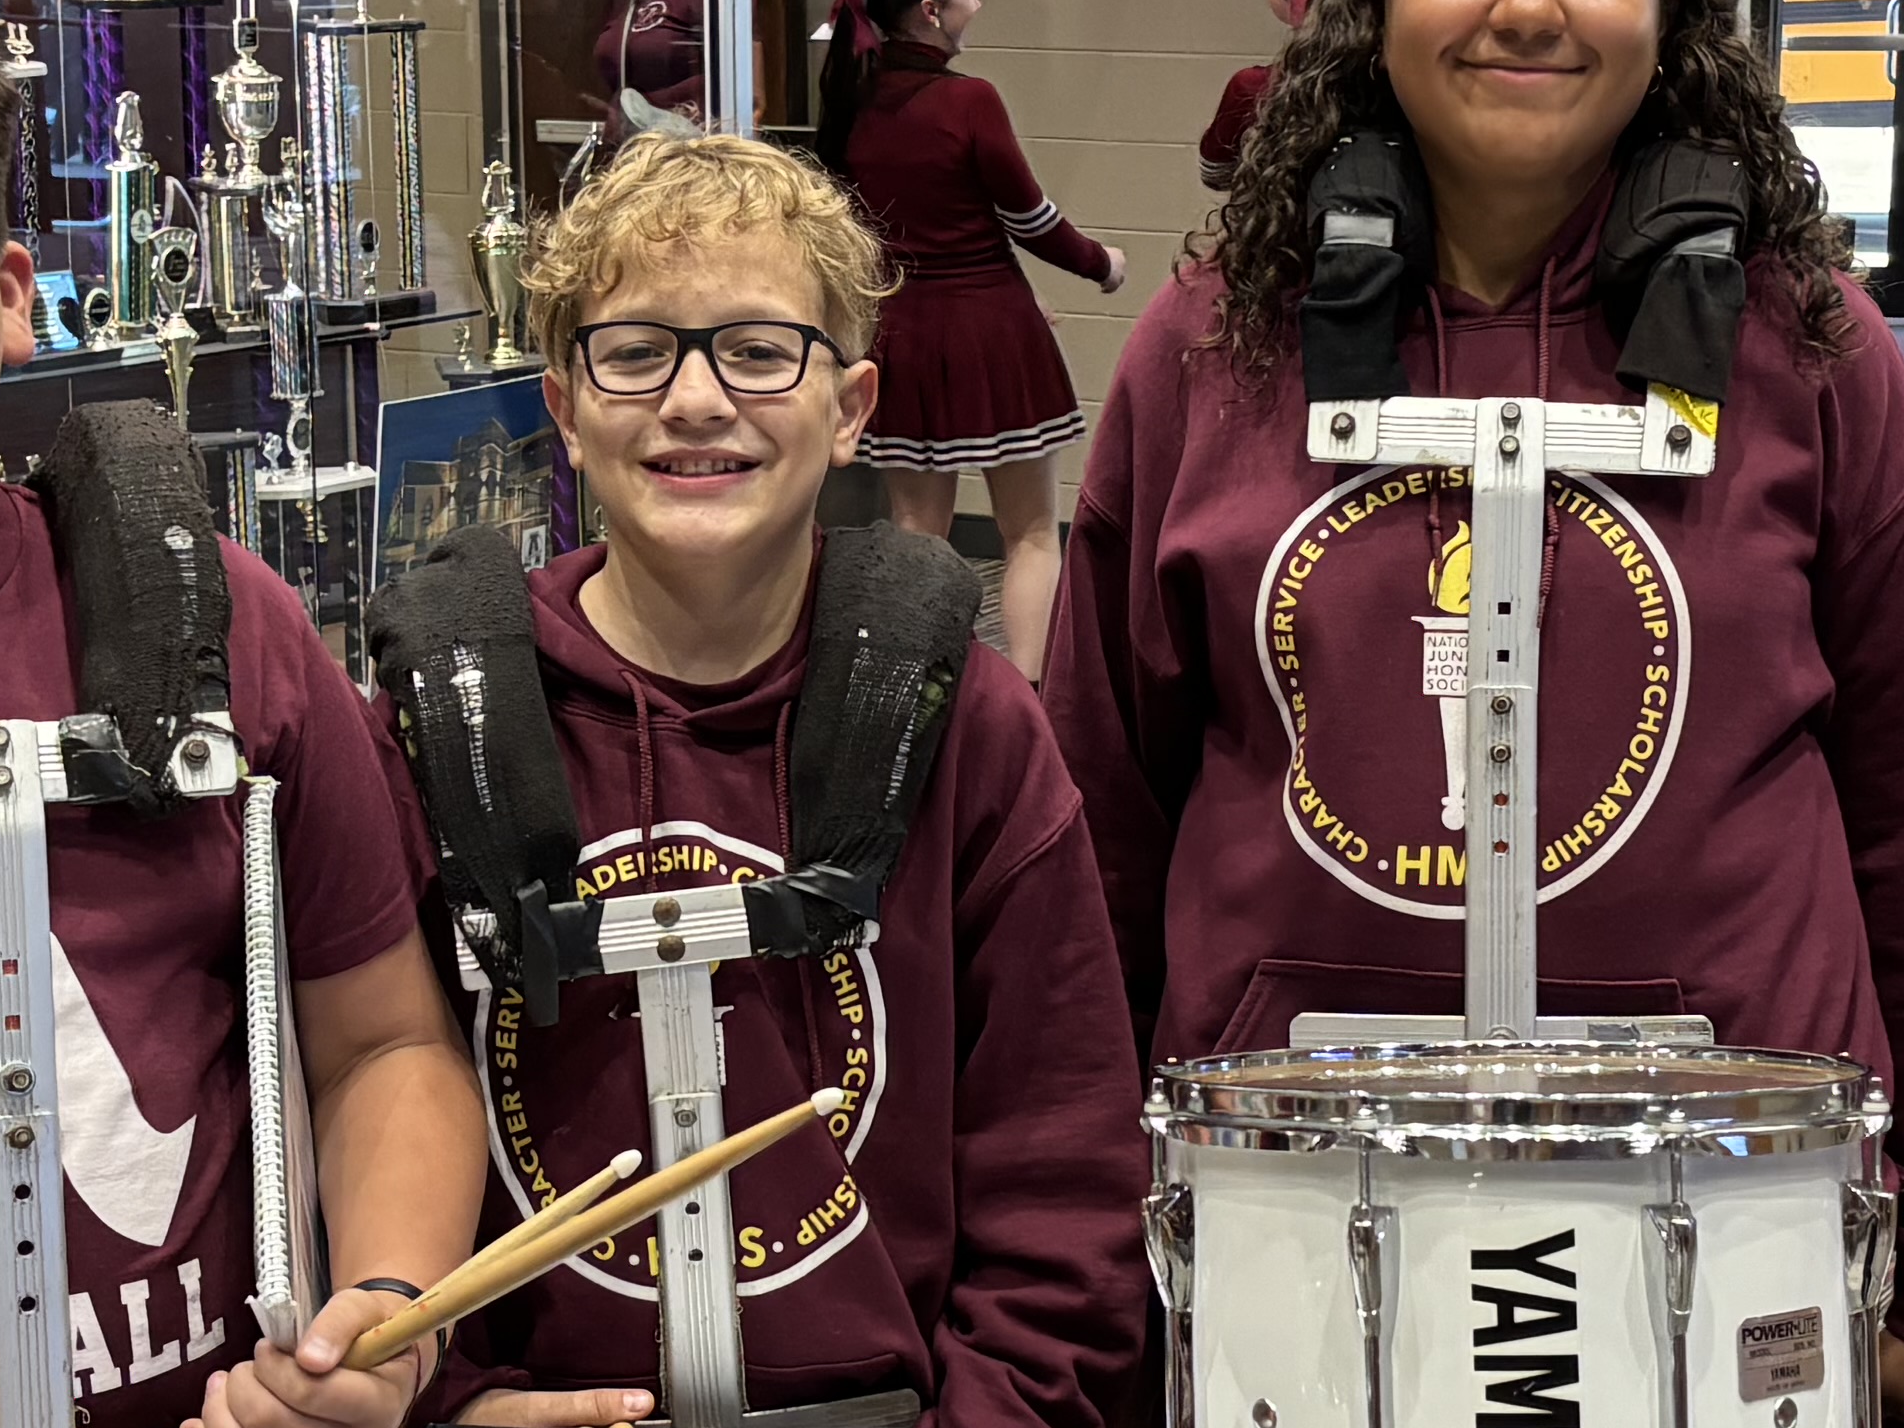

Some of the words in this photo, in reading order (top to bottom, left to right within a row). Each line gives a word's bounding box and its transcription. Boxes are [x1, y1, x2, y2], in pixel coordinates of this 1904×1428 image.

[1326, 465, 1474, 534] LEADES
[1551, 480, 1669, 640] ITIZENSHIP
[1272, 538, 1326, 671] SERVICE
[1426, 635, 1469, 649] NATIO
[1426, 664, 1468, 677] HON
[1427, 650, 1469, 663] JUNI
[1426, 678, 1465, 692] SOCI
[1292, 691, 1370, 864] CHARACER
[1541, 663, 1671, 873] SCHOLARSHIP
[576, 844, 718, 901] ADERSHIP
[1395, 844, 1467, 887] HM
[495, 986, 525, 1070] SERV
